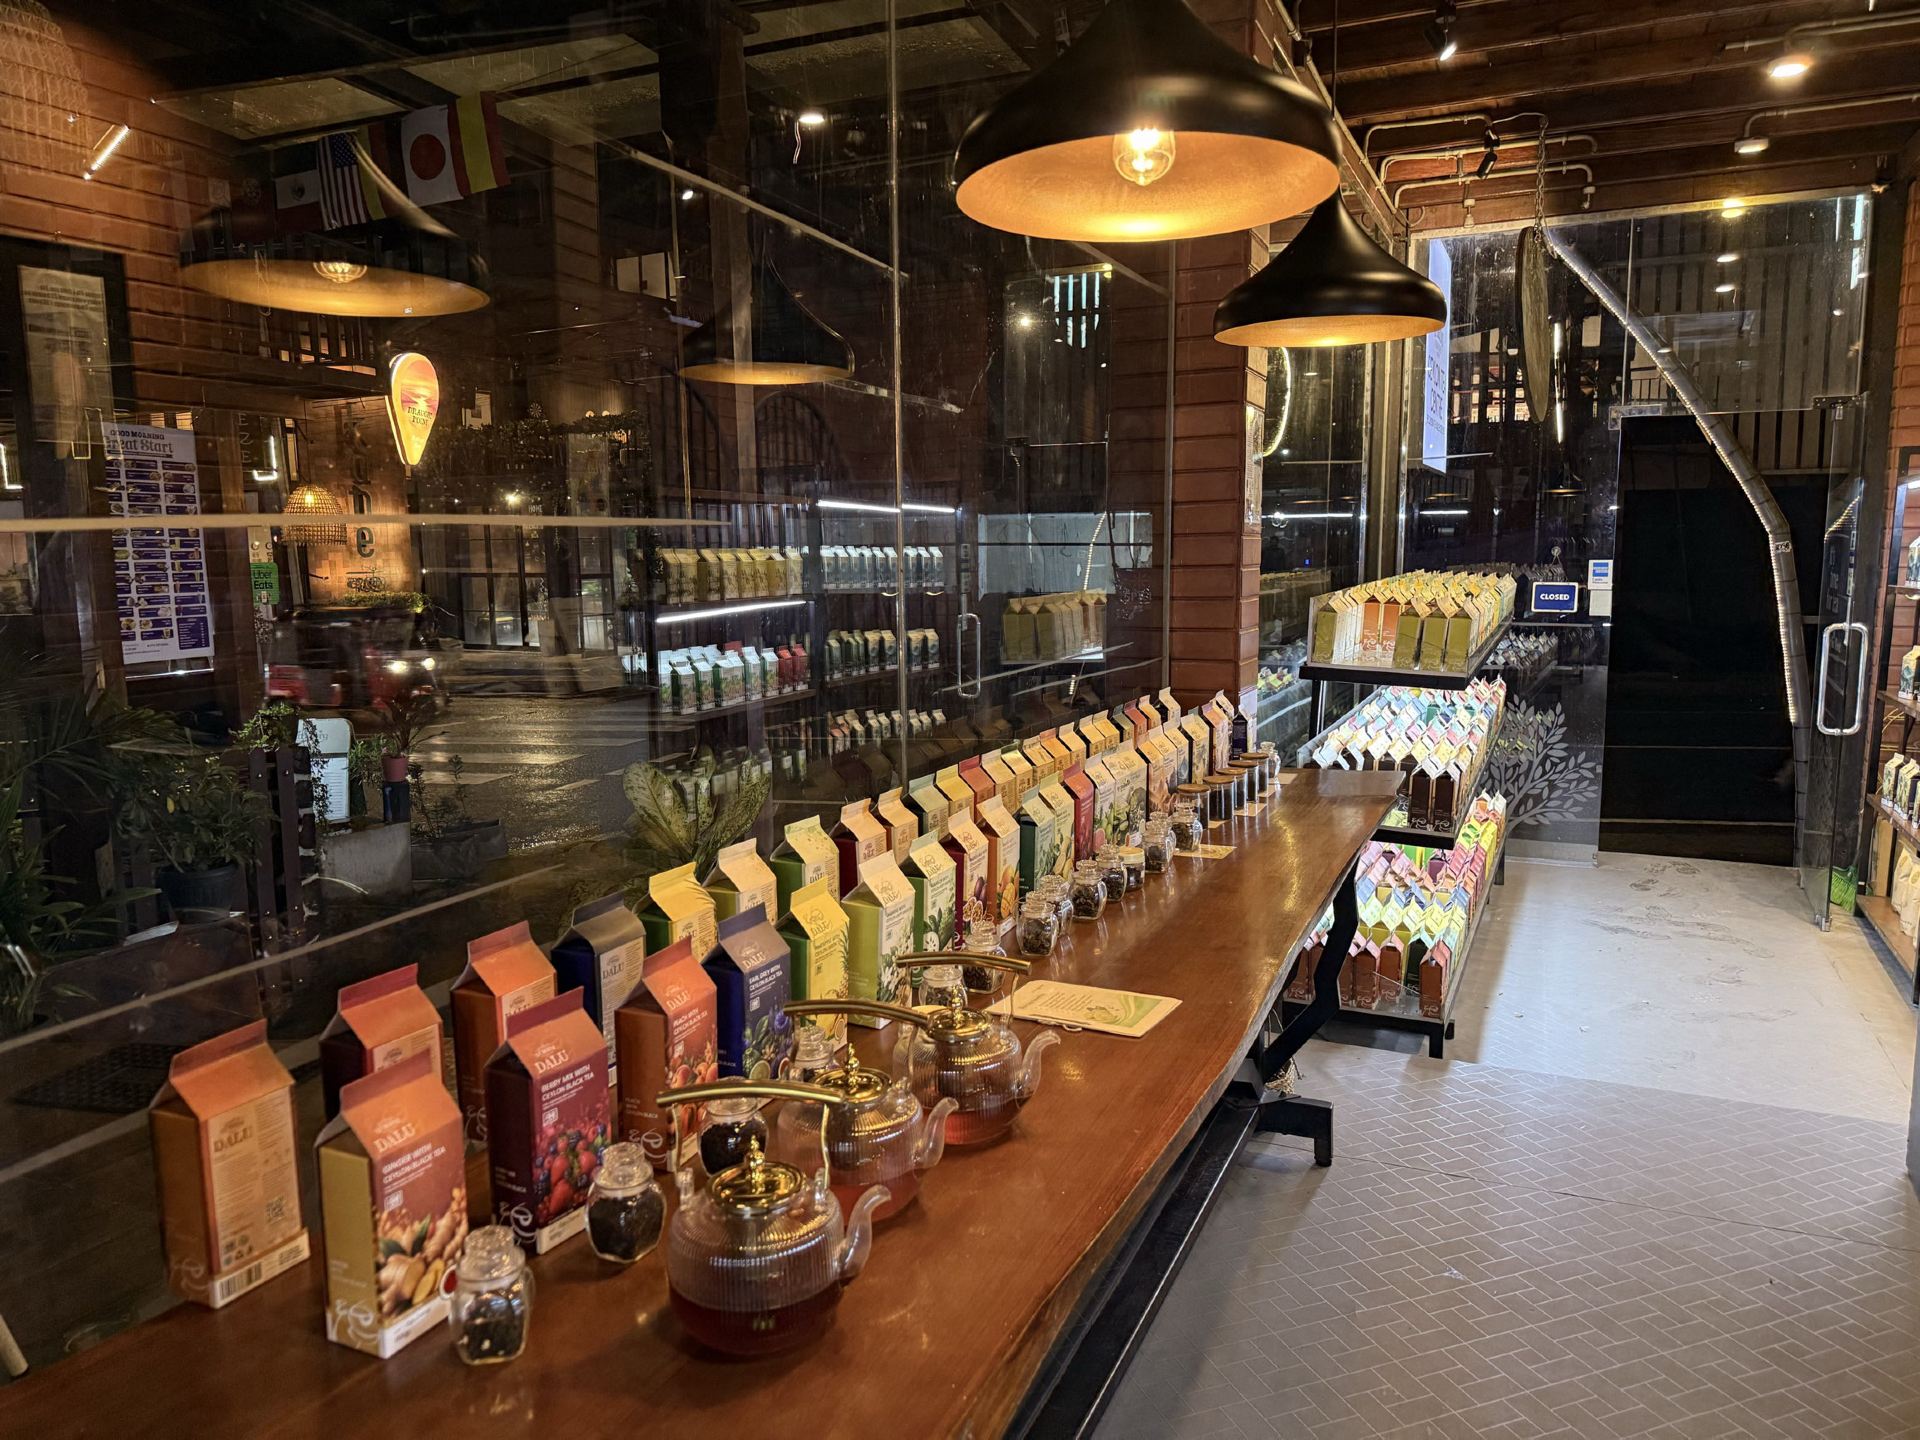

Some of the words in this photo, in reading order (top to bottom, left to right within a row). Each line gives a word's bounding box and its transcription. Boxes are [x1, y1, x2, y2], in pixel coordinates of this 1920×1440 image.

[131, 431, 165, 440] MORNING
[140, 438, 174, 453] Start
[253, 570, 273, 579] Uber
[254, 580, 273, 590] Eats
[1539, 593, 1570, 601] CLOSED
[742, 952, 766, 969] DALU
[602, 962, 625, 980] DALU
[666, 990, 690, 1010] DALU
[534, 1049, 569, 1074] DALU
[541, 1079, 562, 1093] BERRY
[562, 1072, 574, 1083] MIX
[574, 1064, 590, 1077] WITH
[542, 1086, 566, 1101] CEYLON
[565, 1078, 584, 1091] BLACK
[584, 1071, 595, 1081] TEA
[214, 1125, 253, 1153] DALU
[373, 1122, 416, 1153] DALU
[382, 1153, 412, 1175] GINGER
[411, 1142, 433, 1161] WITH
[382, 1162, 413, 1184] CEYLON
[412, 1152, 434, 1169] BLACK
[433, 1145, 447, 1158] TEA
